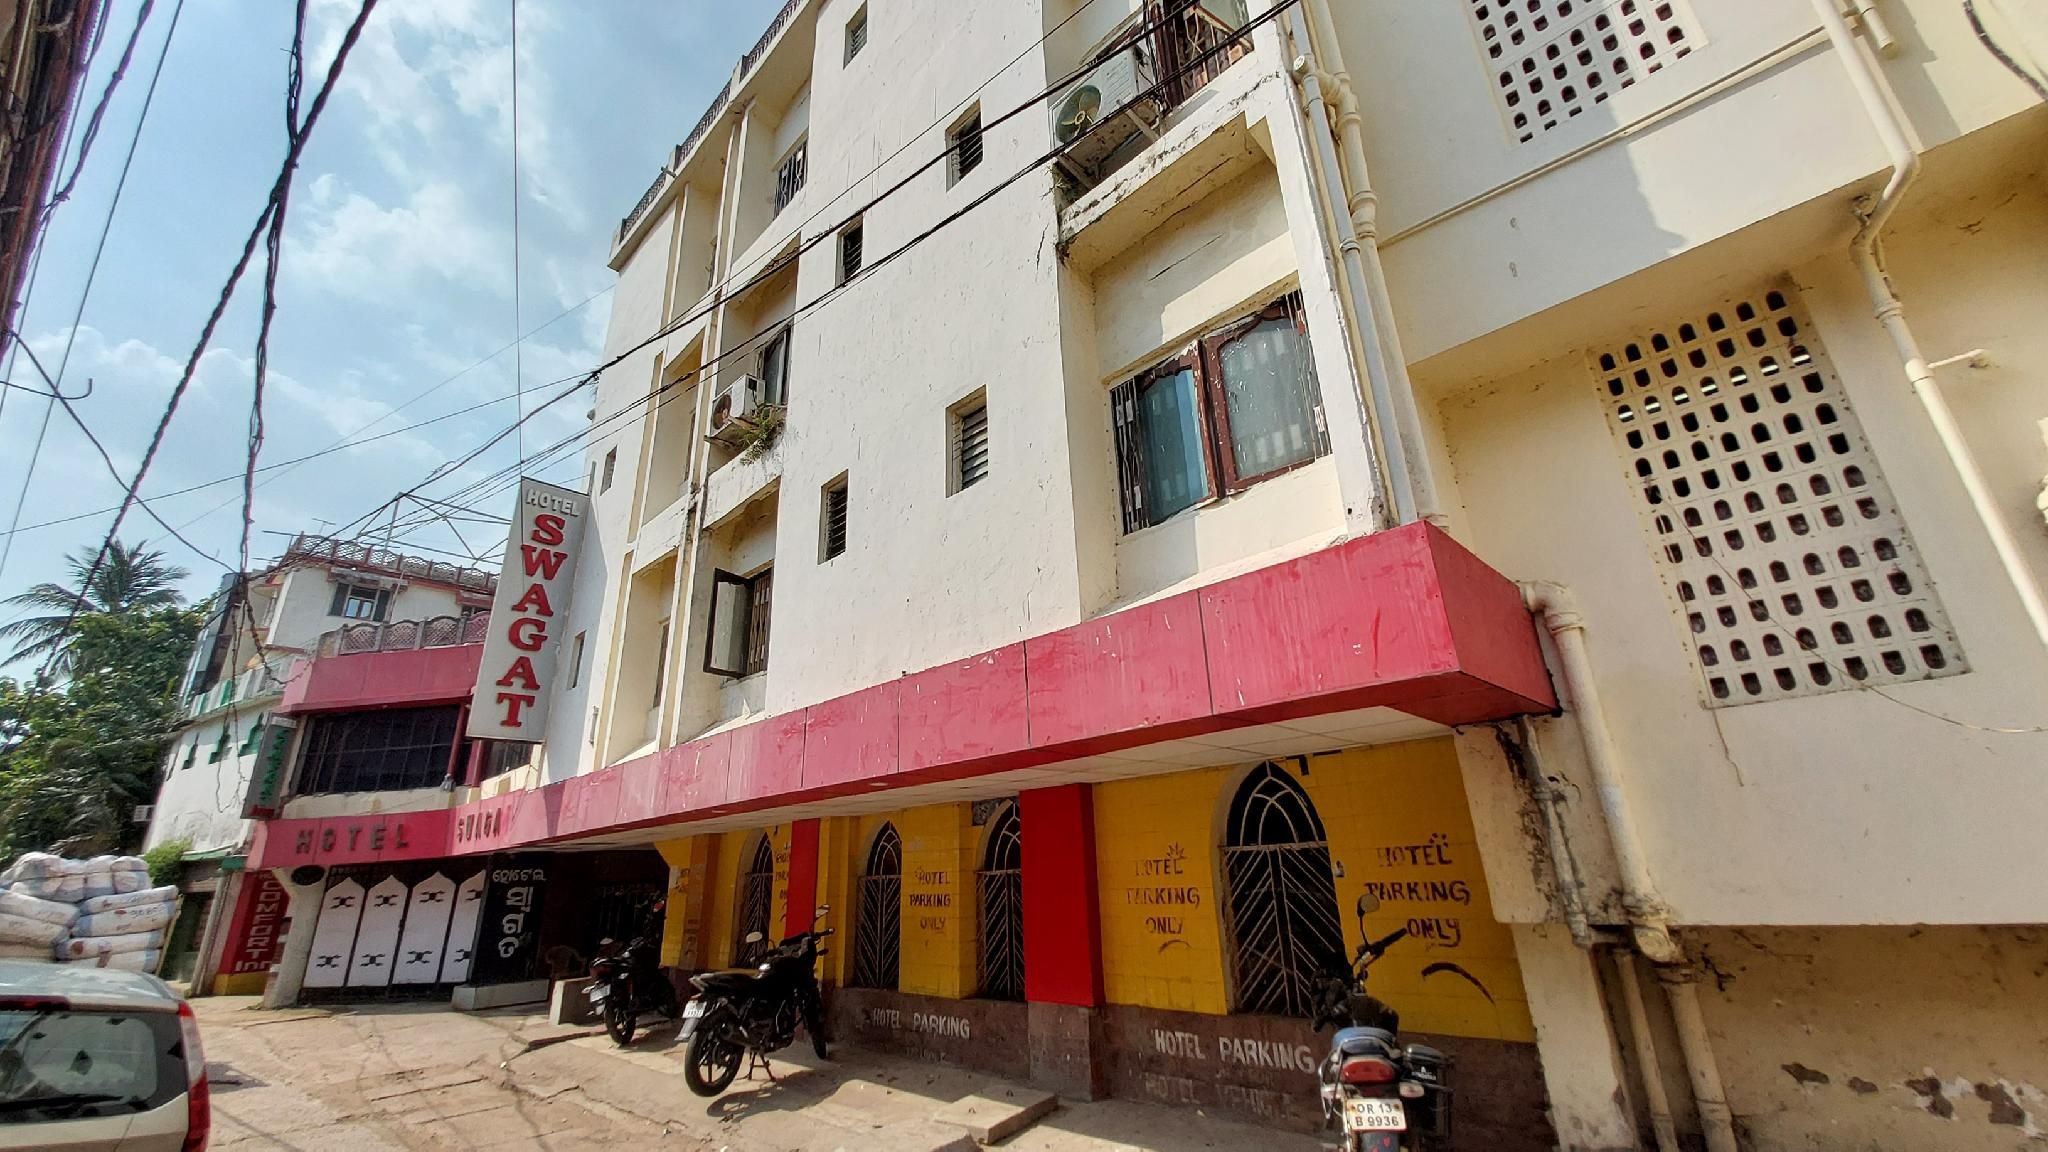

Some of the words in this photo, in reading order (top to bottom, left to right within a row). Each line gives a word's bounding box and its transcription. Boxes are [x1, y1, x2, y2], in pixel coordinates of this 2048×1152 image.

[526, 488, 580, 517] HOTEL
[496, 513, 568, 728] SWAGAT
[295, 824, 410, 854] HOTEL
[1375, 844, 1453, 868] HOTEL
[909, 893, 951, 908] PARKING
[1363, 880, 1471, 906] PARKING
[244, 880, 282, 960] COMFORT
[1406, 917, 1461, 948] ONLY
[235, 960, 273, 973] Inn
[873, 1007, 902, 1029] HOTEL
[913, 1012, 970, 1041] PARKING
[1153, 1028, 1206, 1060] HOTEL
[1218, 1036, 1317, 1075] PARKING
[1355, 1116, 1364, 1126] B
[1367, 1115, 1399, 1127] 9936
[1380, 1103, 1393, 1114] 13
